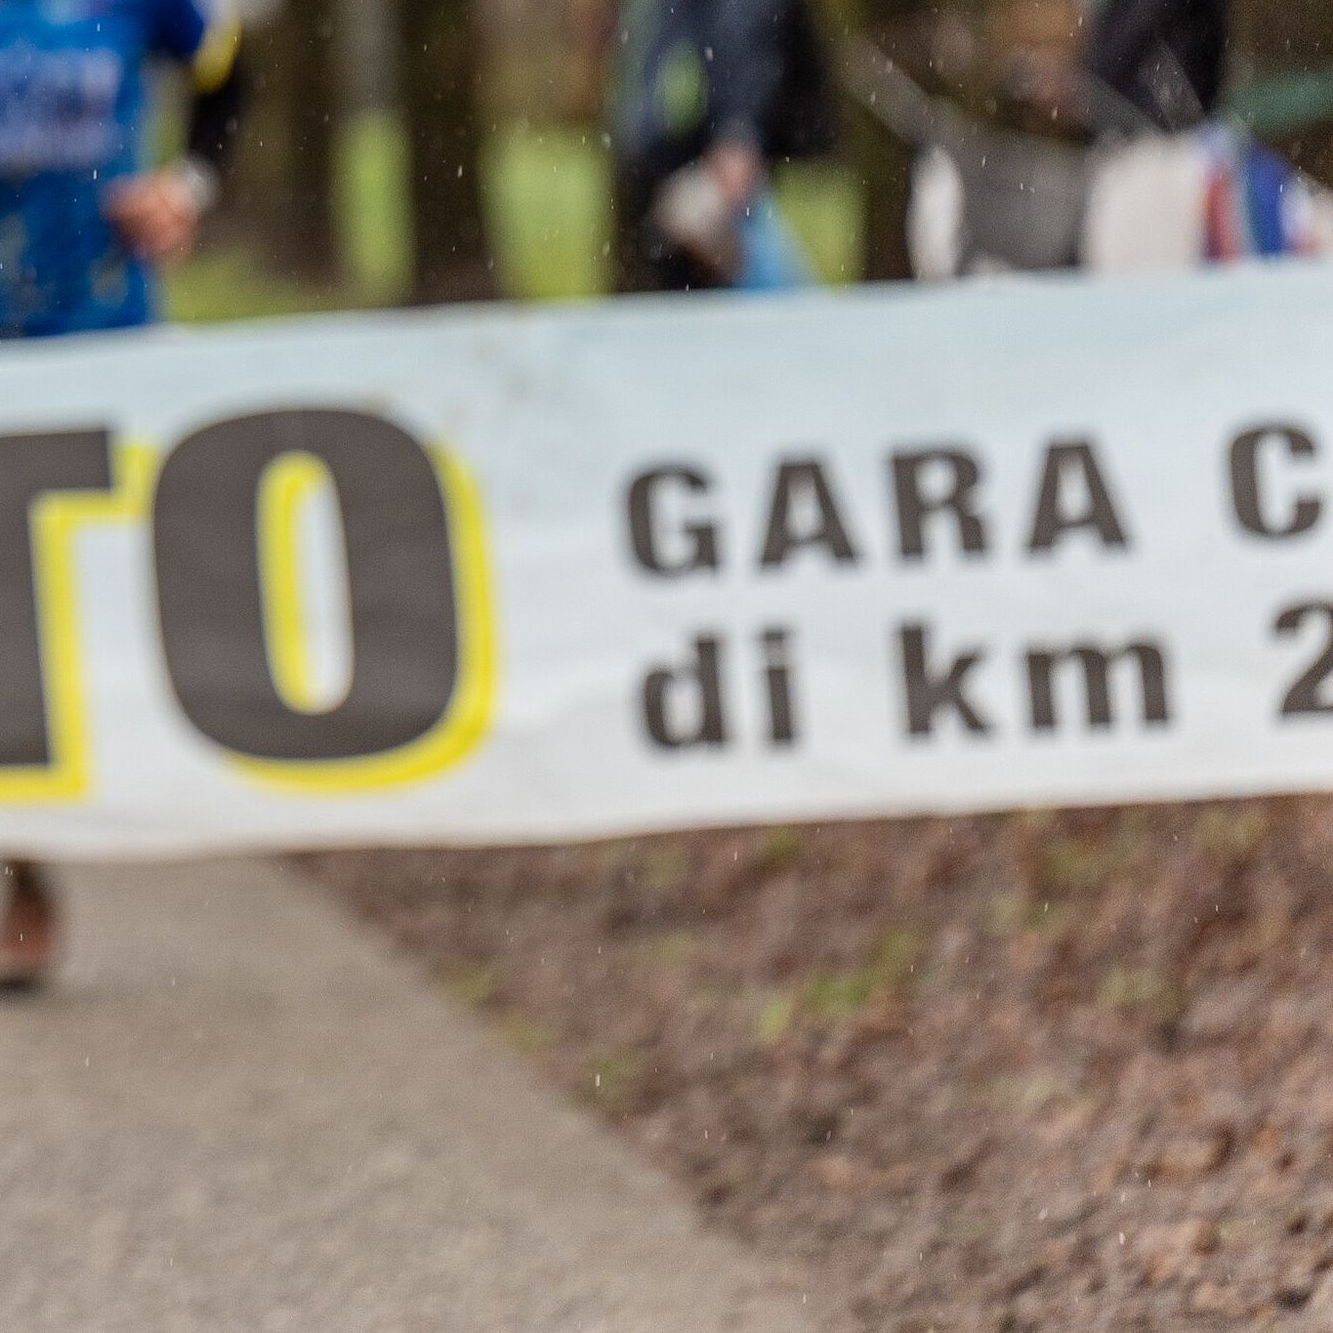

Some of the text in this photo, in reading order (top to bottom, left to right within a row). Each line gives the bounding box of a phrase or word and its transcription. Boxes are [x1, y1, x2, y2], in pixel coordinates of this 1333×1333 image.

[622, 420, 1323, 578] GARA C
[638, 622, 801, 751] di
[896, 616, 1176, 746] km
